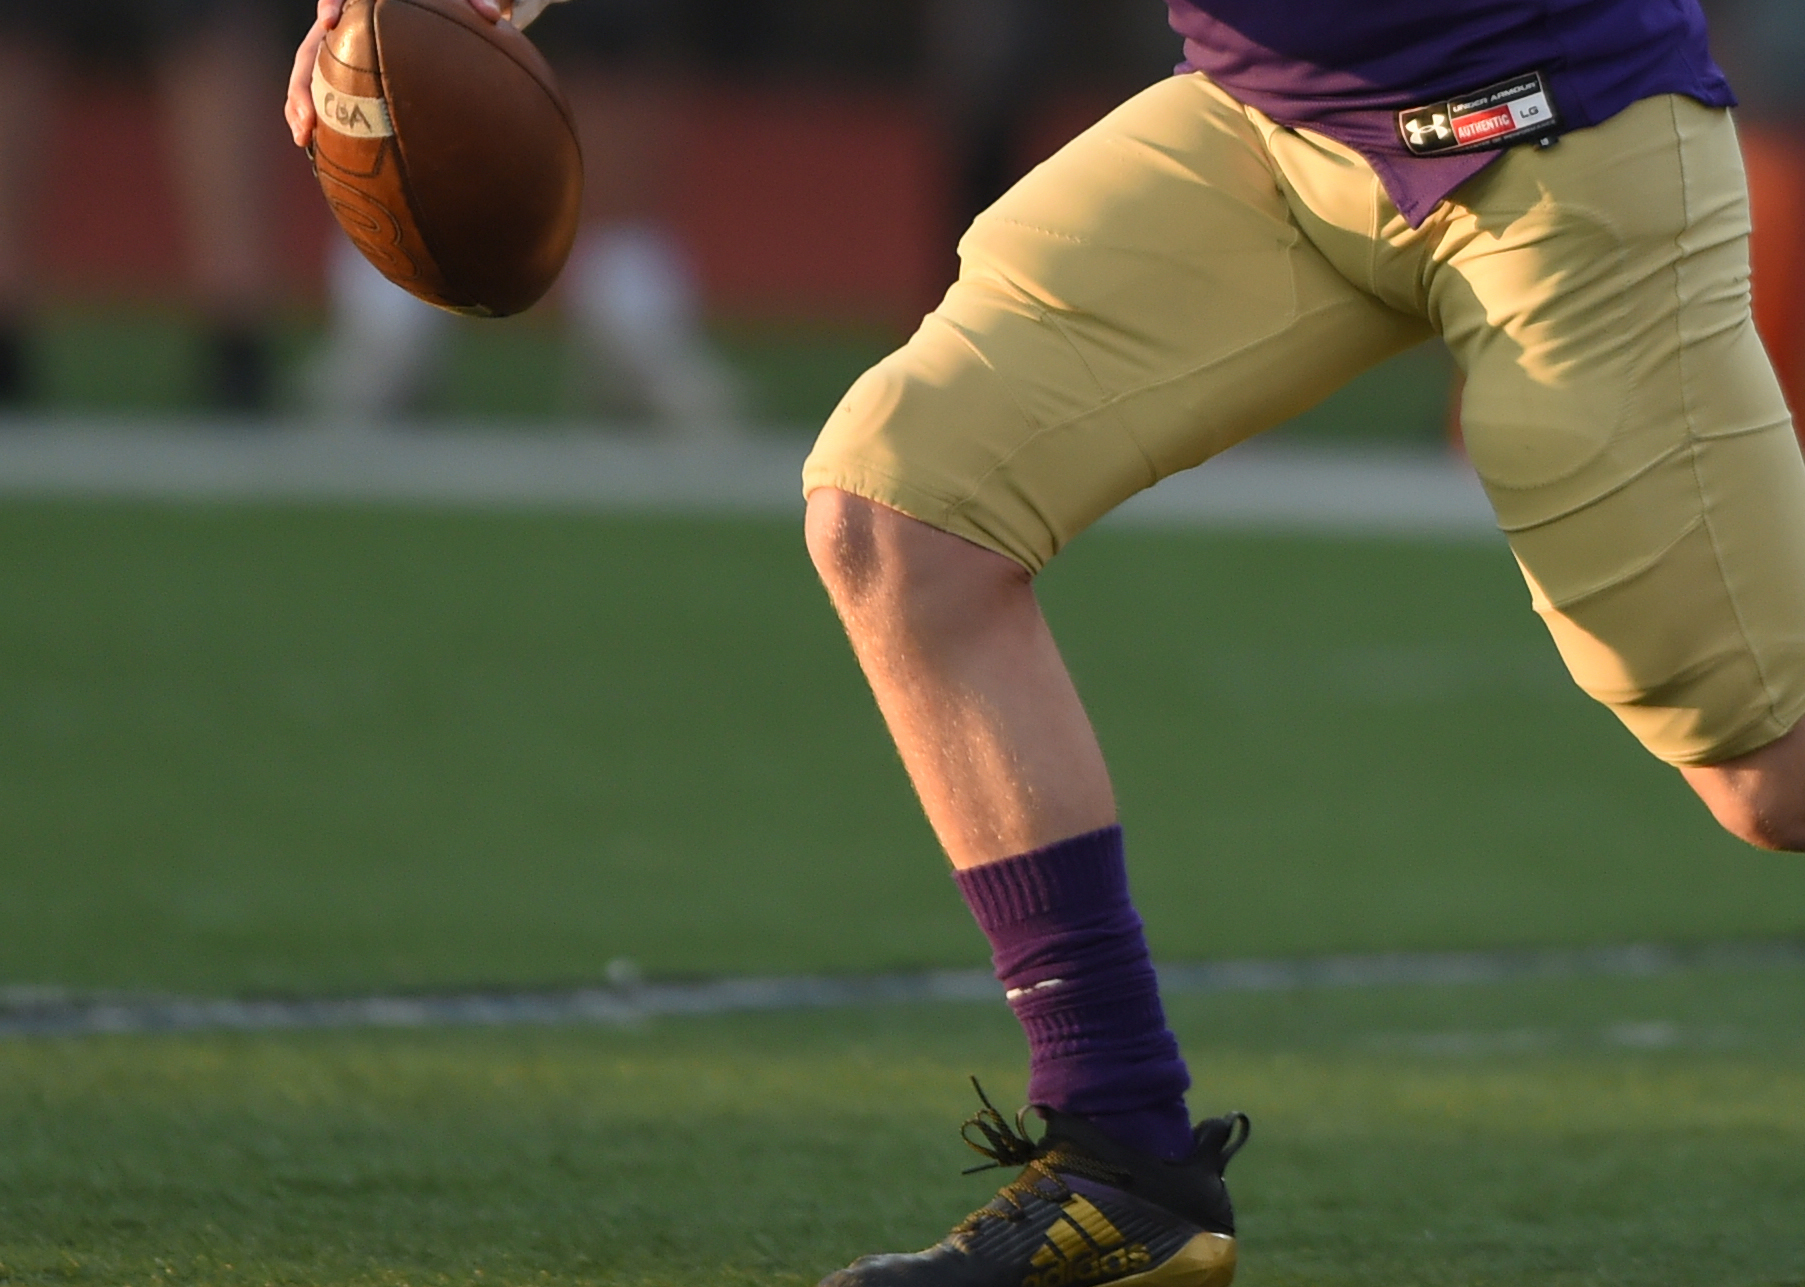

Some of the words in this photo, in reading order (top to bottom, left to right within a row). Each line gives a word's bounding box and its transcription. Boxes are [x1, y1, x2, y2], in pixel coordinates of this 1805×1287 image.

[1453, 99, 1488, 112] UNDER
[1490, 82, 1536, 101] ARMOUR
[1458, 115, 1510, 138] AUTHENTIC
[1520, 106, 1539, 118] LG
